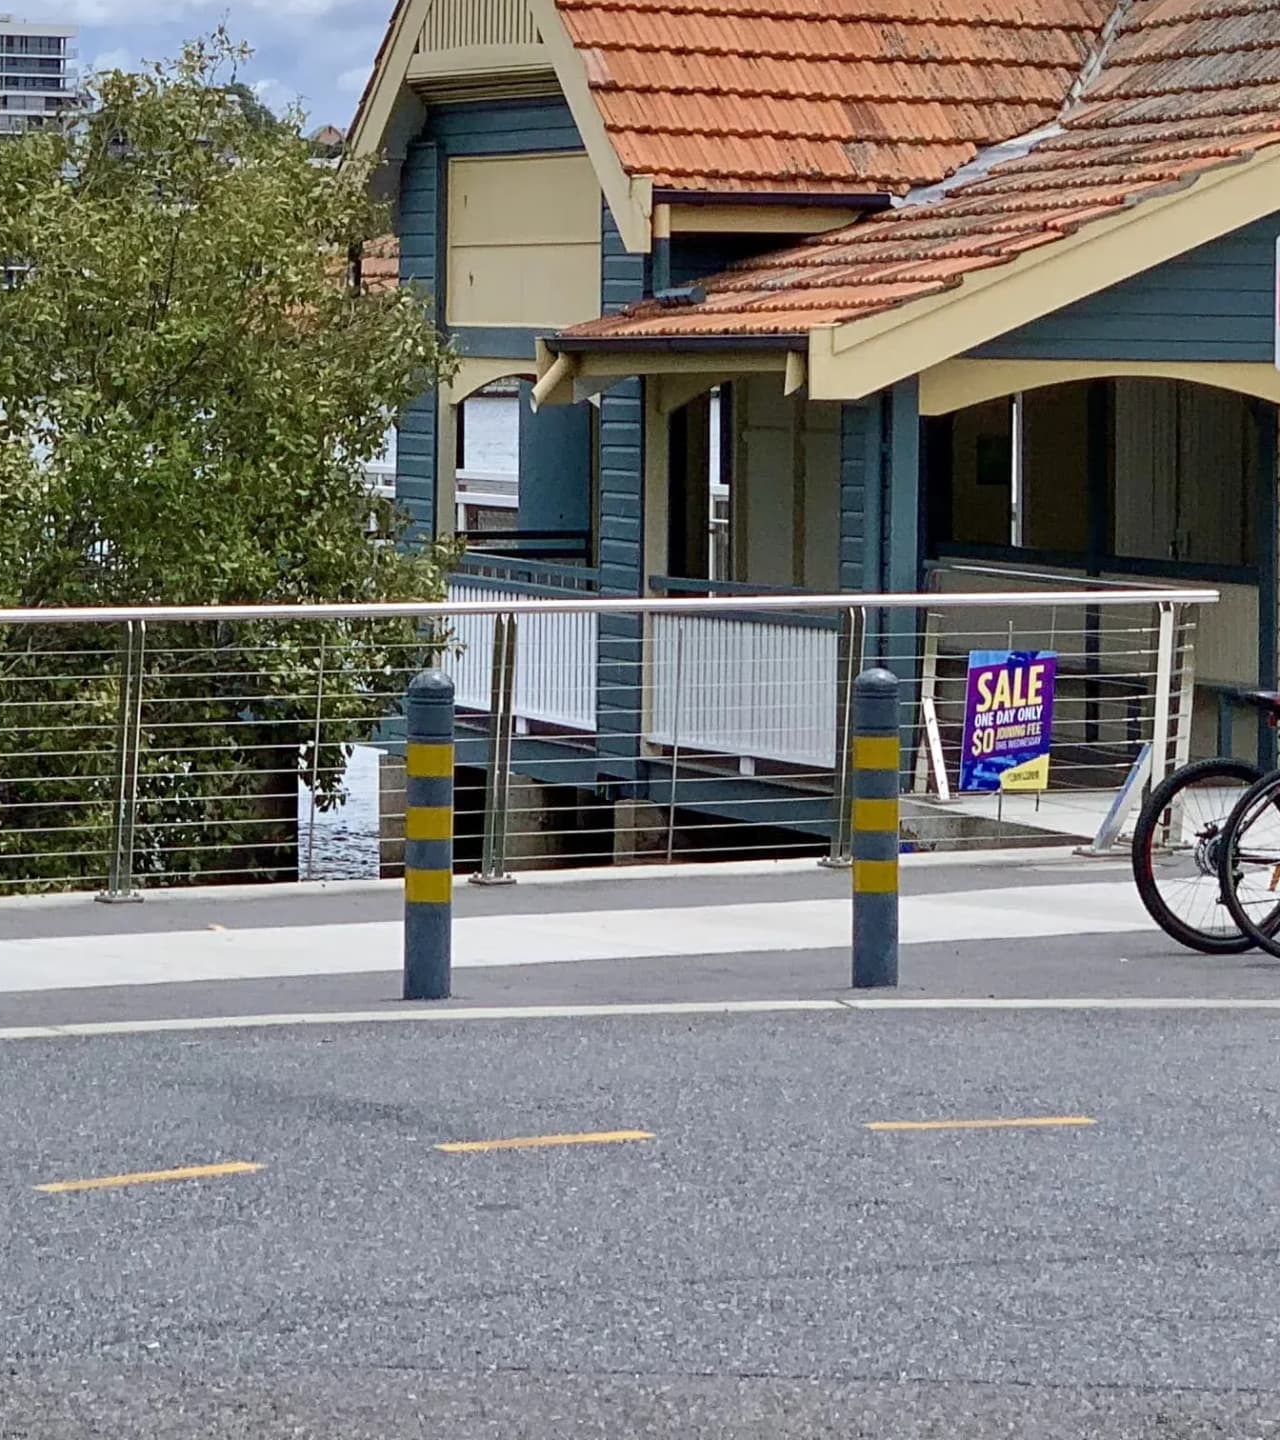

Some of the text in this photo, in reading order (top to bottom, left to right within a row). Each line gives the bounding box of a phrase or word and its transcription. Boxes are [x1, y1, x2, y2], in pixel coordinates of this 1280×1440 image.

[976, 664, 1044, 712] SALE
[974, 705, 1043, 728] ONE DAY ONLY
[1026, 721, 1043, 736] FEE
[971, 727, 995, 756] $0
